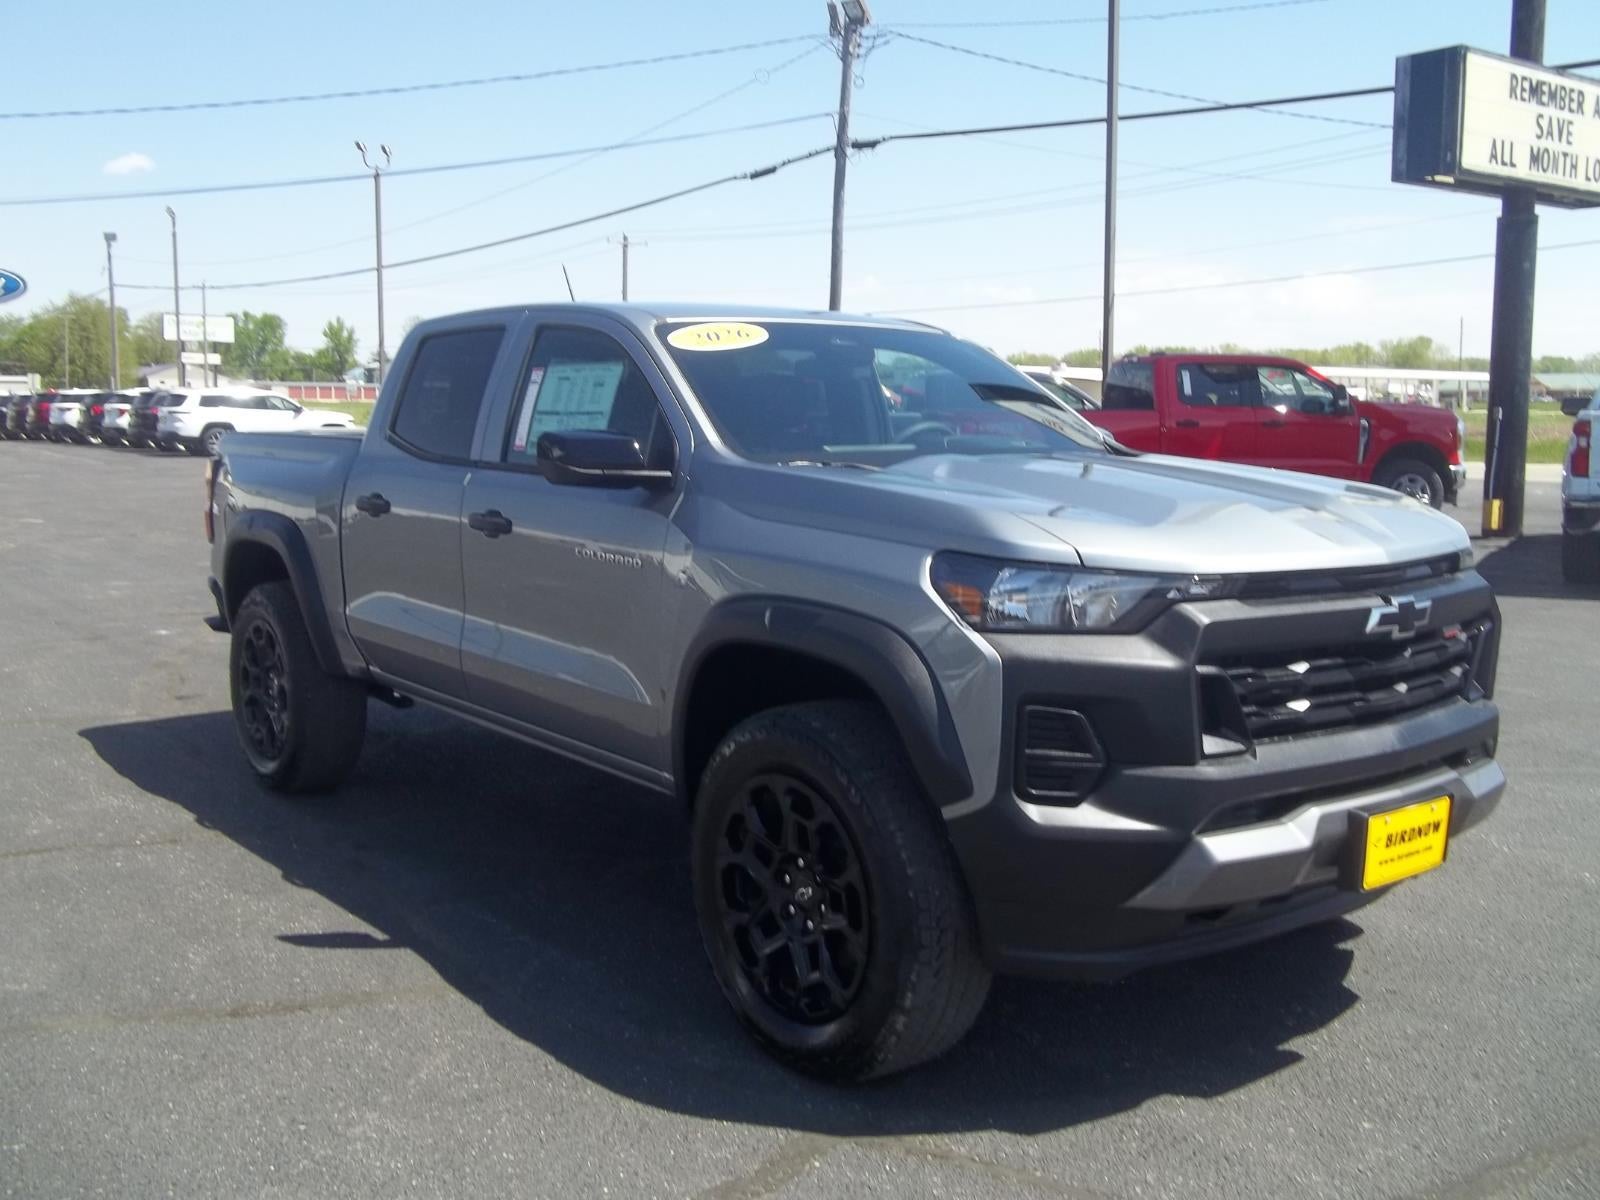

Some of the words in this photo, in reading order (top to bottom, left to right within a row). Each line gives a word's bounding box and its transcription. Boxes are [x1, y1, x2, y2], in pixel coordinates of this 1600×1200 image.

[1509, 73, 1585, 116] REMEMBER
[1535, 113, 1575, 145] SAVE
[1489, 138, 1517, 168] ALL
[1529, 145, 1578, 179] MONTH
[575, 546, 642, 569] COLORADO
[1385, 820, 1441, 849] BIRDNOW
